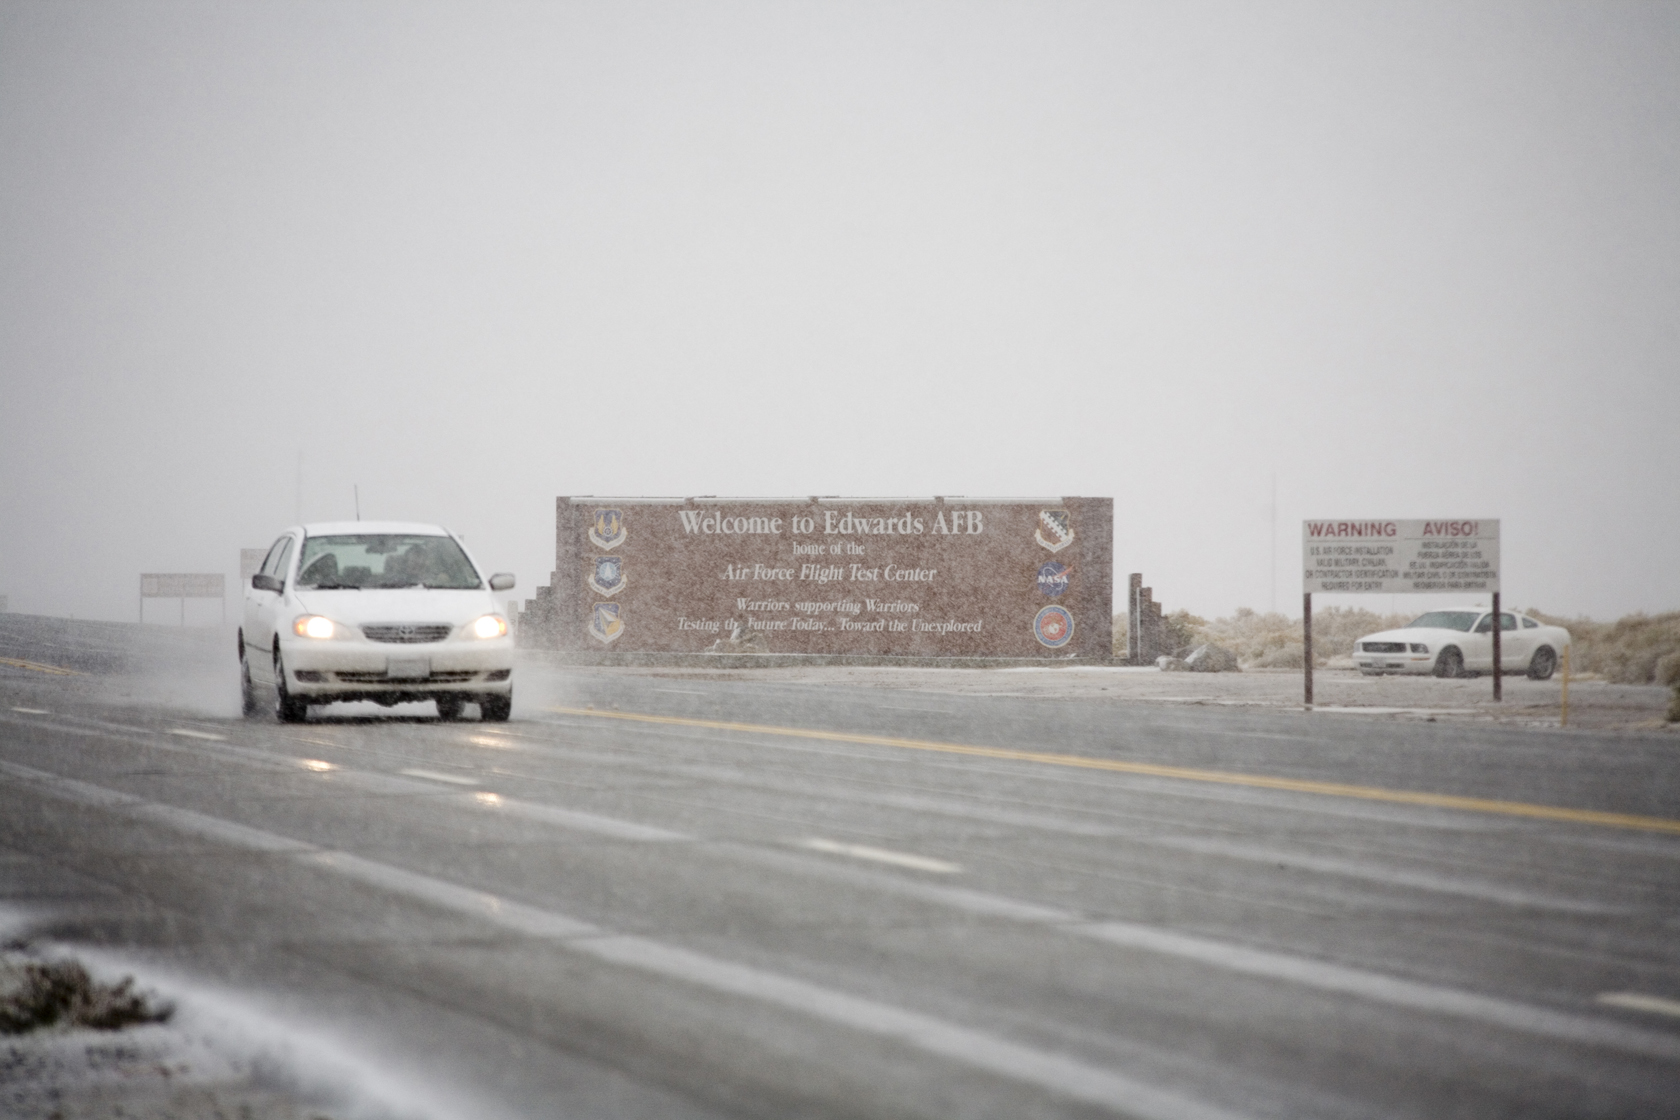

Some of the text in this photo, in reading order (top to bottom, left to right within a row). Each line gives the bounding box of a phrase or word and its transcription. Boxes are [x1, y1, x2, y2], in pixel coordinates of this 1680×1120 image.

[678, 510, 983, 535] Welcome to Edwards AFB
[1307, 522, 1397, 537] WARNING
[1422, 521, 1479, 537] AVISO!
[793, 541, 865, 555] home of the
[722, 563, 937, 584] Air Force Flight Test Center
[1037, 573, 1069, 584] NASA
[737, 597, 920, 616] Warriors supporting Warriors
[678, 617, 720, 634] Testing
[747, 617, 788, 631] Future
[840, 618, 885, 632] Toward
[888, 619, 908, 632] the
[912, 618, 983, 635] Unexplored
